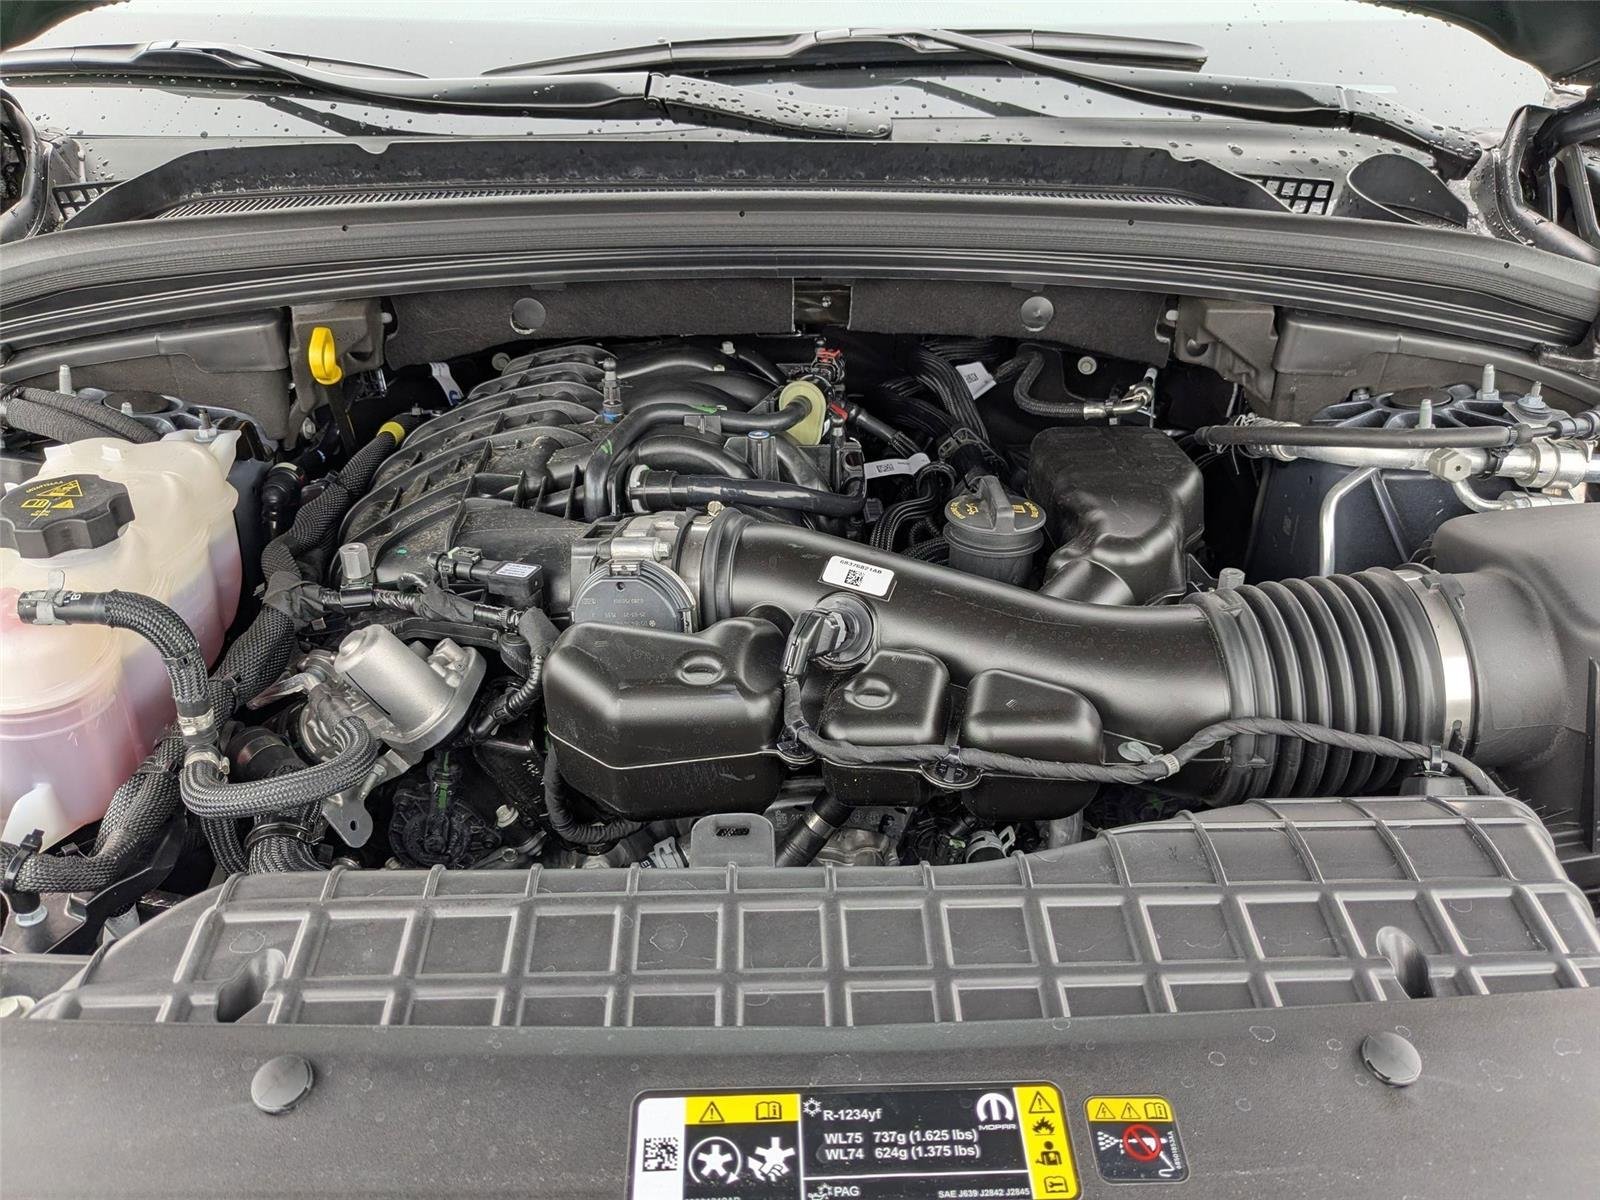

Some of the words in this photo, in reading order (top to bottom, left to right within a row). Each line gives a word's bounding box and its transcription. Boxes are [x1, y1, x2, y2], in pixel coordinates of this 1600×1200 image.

[823, 1108, 882, 1122] R-1234yf
[978, 1123, 1016, 1131] MOPAR
[824, 1132, 863, 1145] WL75
[873, 1131, 906, 1145] 737g
[909, 1129, 949, 1145] (1.625
[952, 1128, 978, 1143] lbs)
[825, 1148, 864, 1161] WL74
[874, 1147, 908, 1161] 624g
[911, 1145, 952, 1161] (1.375
[954, 1144, 981, 1159] lbs)
[834, 1186, 860, 1197] PAG
[938, 1189, 957, 1199] SAE
[958, 1189, 978, 1198] J639
[979, 1188, 1005, 1198] J2842
[1006, 1187, 1031, 1197] J2845
